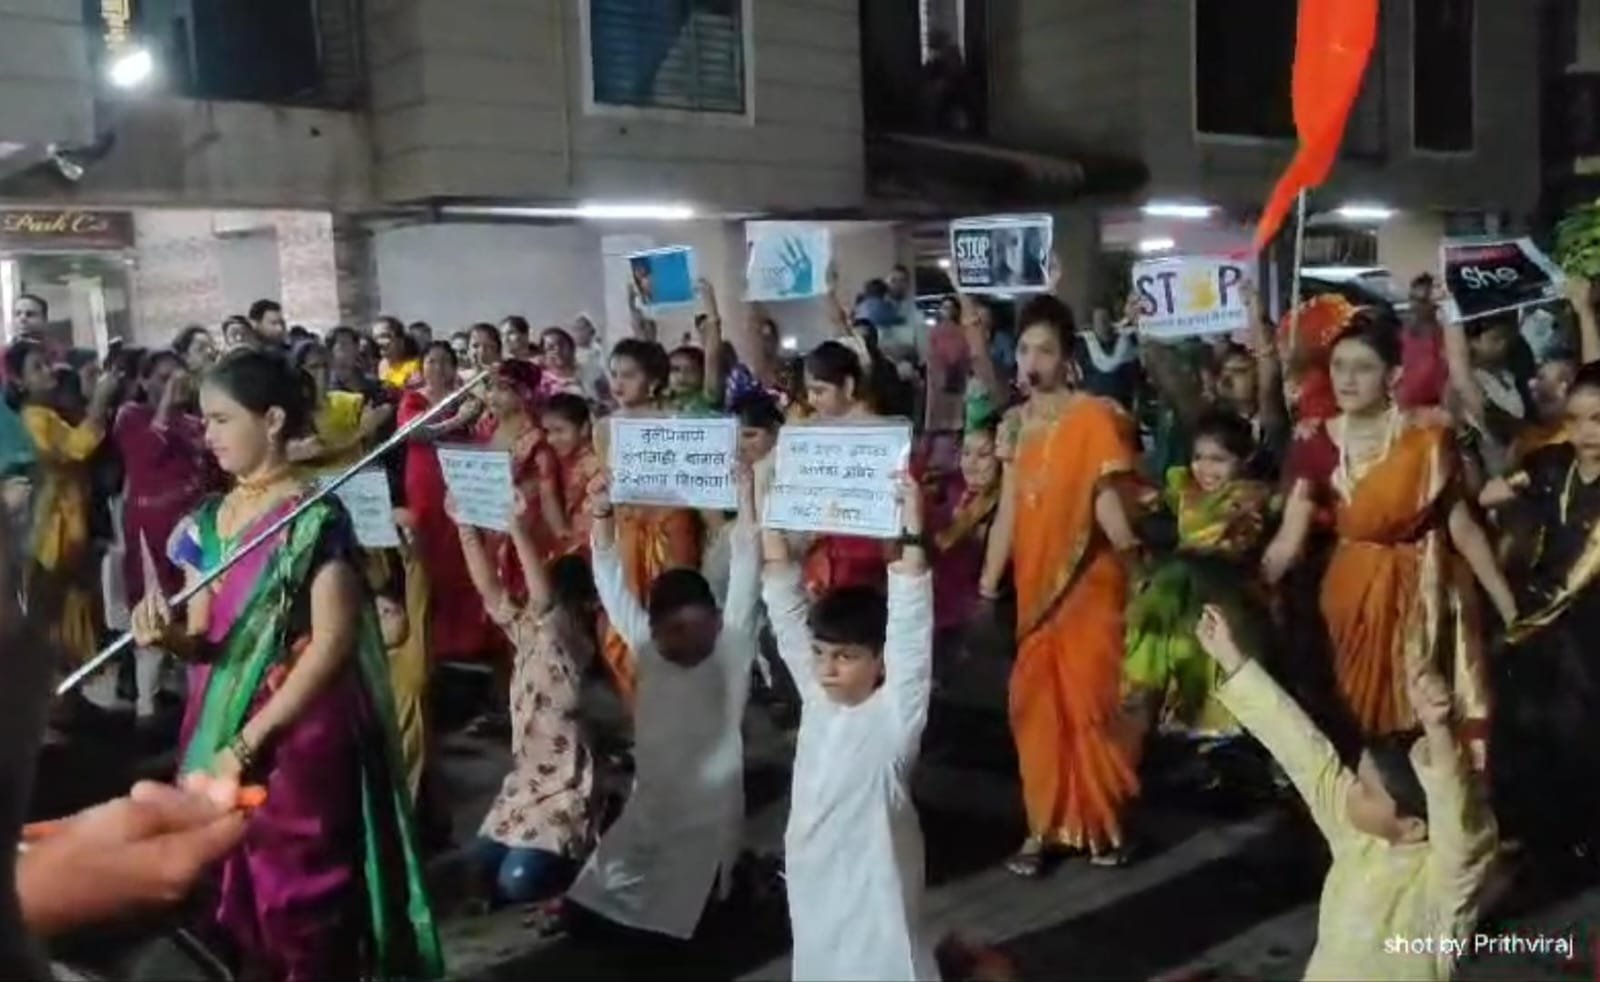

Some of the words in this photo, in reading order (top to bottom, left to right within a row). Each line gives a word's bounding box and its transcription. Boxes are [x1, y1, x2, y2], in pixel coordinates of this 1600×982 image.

[957, 236, 990, 259] STOP
[1460, 266, 1519, 289] She
[1136, 265, 1242, 317] STP
